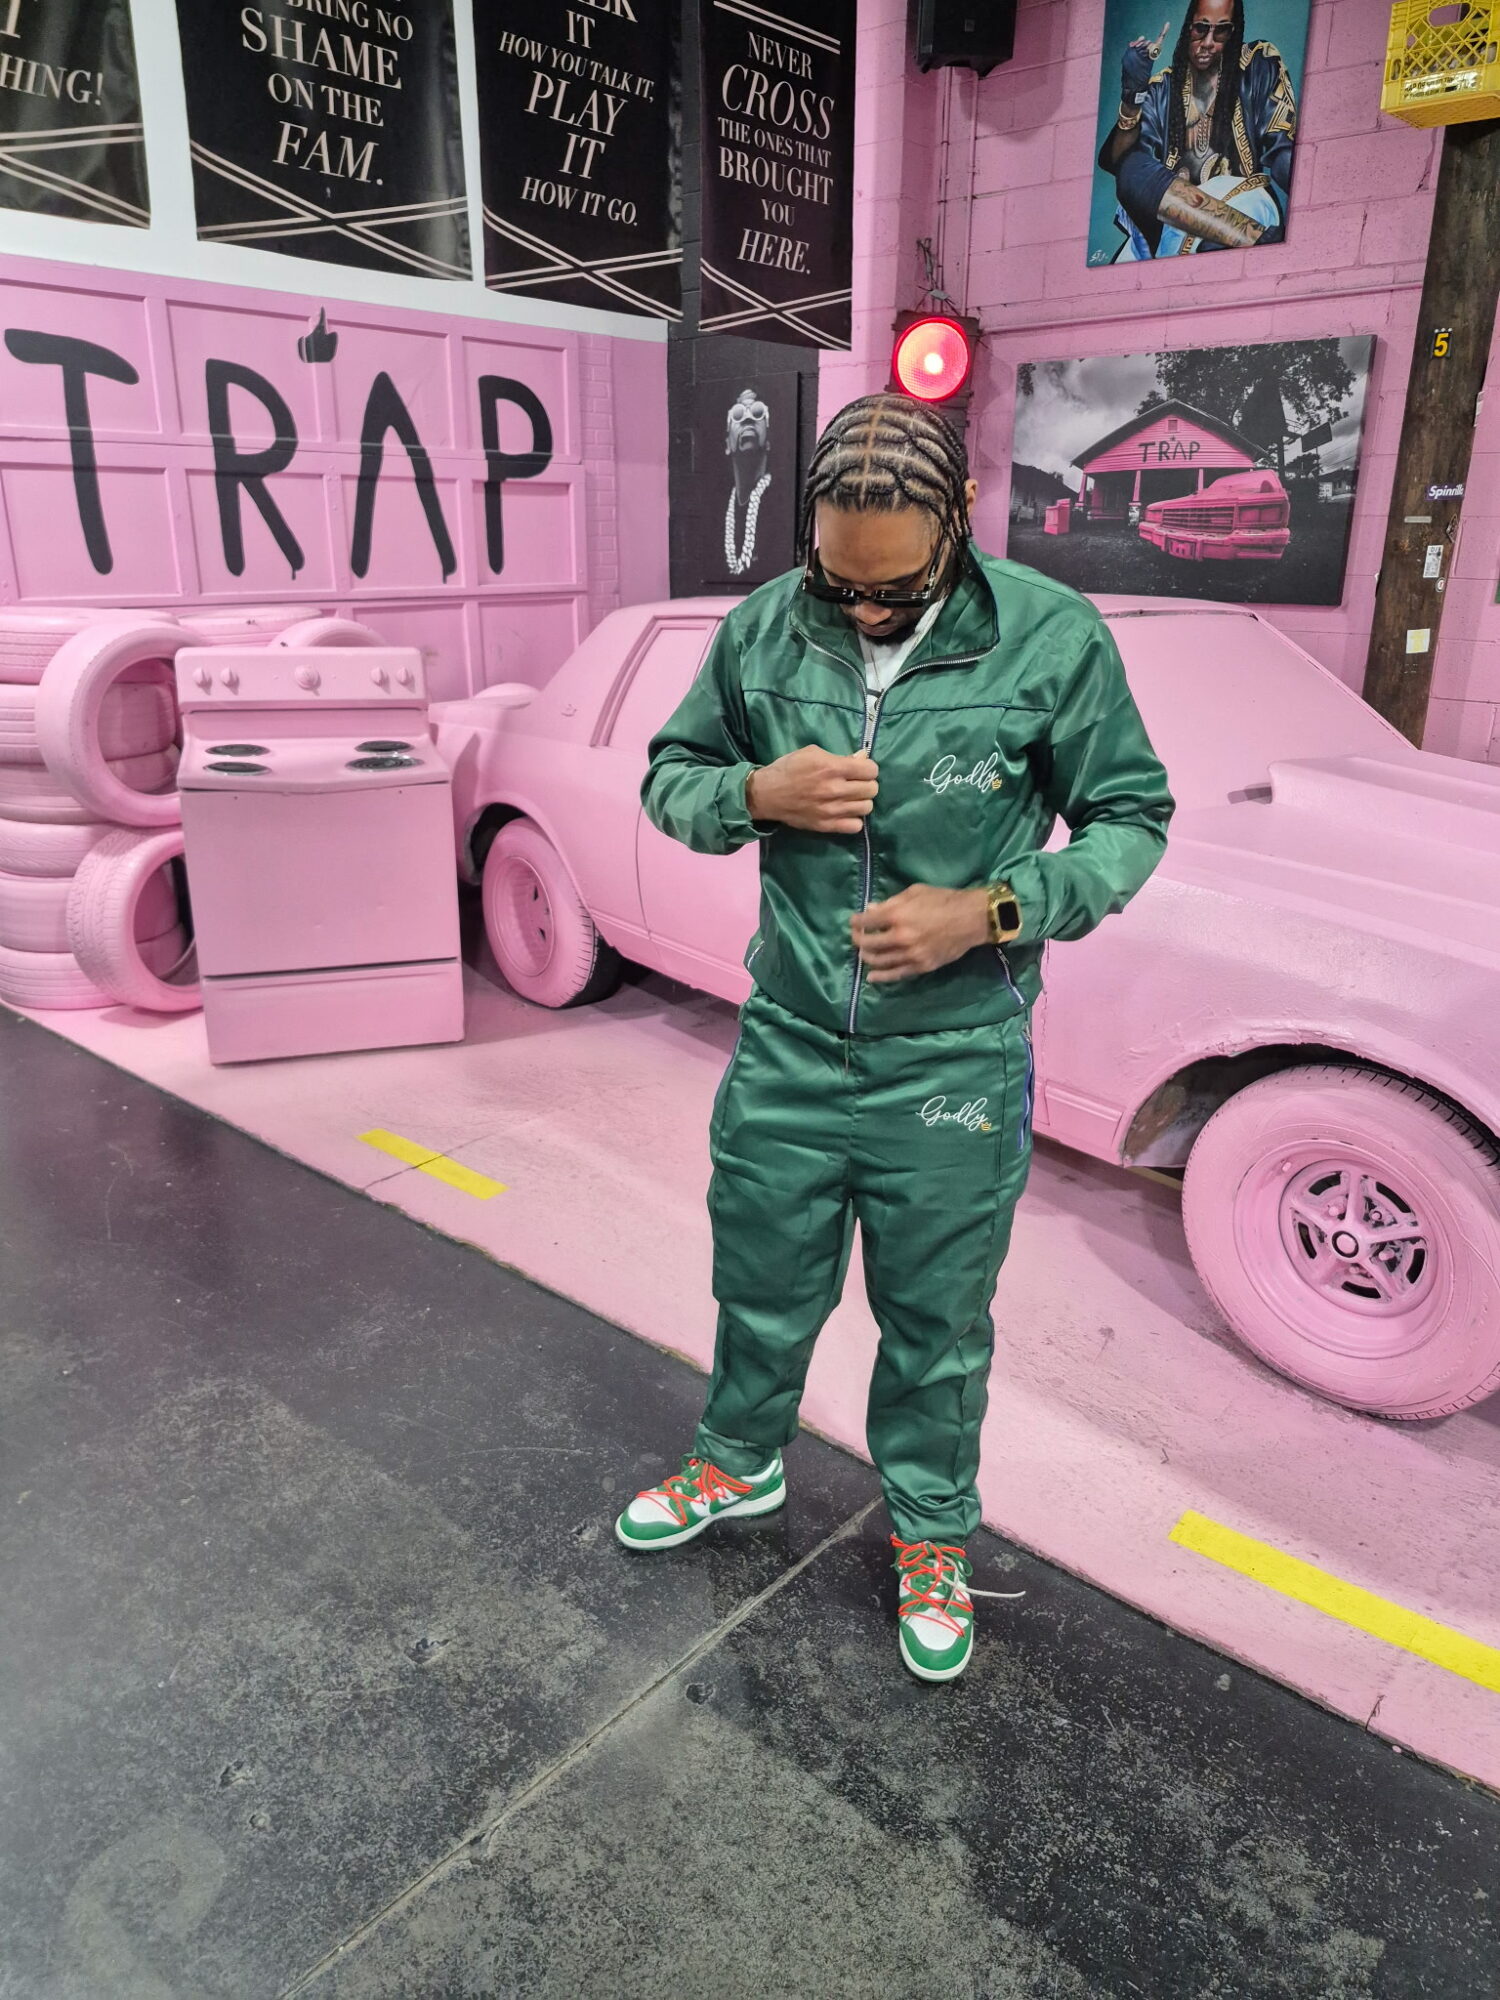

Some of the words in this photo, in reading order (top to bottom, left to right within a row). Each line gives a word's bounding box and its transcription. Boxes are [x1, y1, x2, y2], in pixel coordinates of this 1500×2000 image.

[284, 0, 369, 28] RING
[375, 8, 414, 41] NO
[566, 9, 596, 49] IT
[241, 7, 402, 90] SHAME
[498, 30, 549, 64] HOW
[551, 47, 588, 77] YOU
[590, 60, 633, 93] TALK
[634, 76, 655, 103] IT,
[748, 31, 813, 80] NEVER
[267, 72, 315, 111] ON
[320, 84, 385, 127] THE
[523, 70, 628, 137] PLAY
[721, 63, 835, 140] CROSS
[272, 120, 384, 186] FAM.
[558, 132, 606, 180] IT
[717, 116, 751, 144] THE
[754, 128, 793, 157] ONES
[795, 140, 832, 168] THAT
[718, 145, 834, 206] BROUGHT
[519, 176, 579, 210] HOW
[580, 191, 606, 217] IT
[607, 198, 638, 226] GO.
[760, 198, 796, 227] YOU
[736, 227, 811, 275] HERE.
[1433, 332, 1450, 358] 5
[4, 328, 554, 584] TRAP
[1137, 440, 1201, 463] TRAP
[921, 752, 999, 794] Godly
[915, 1095, 989, 1132] Godly
